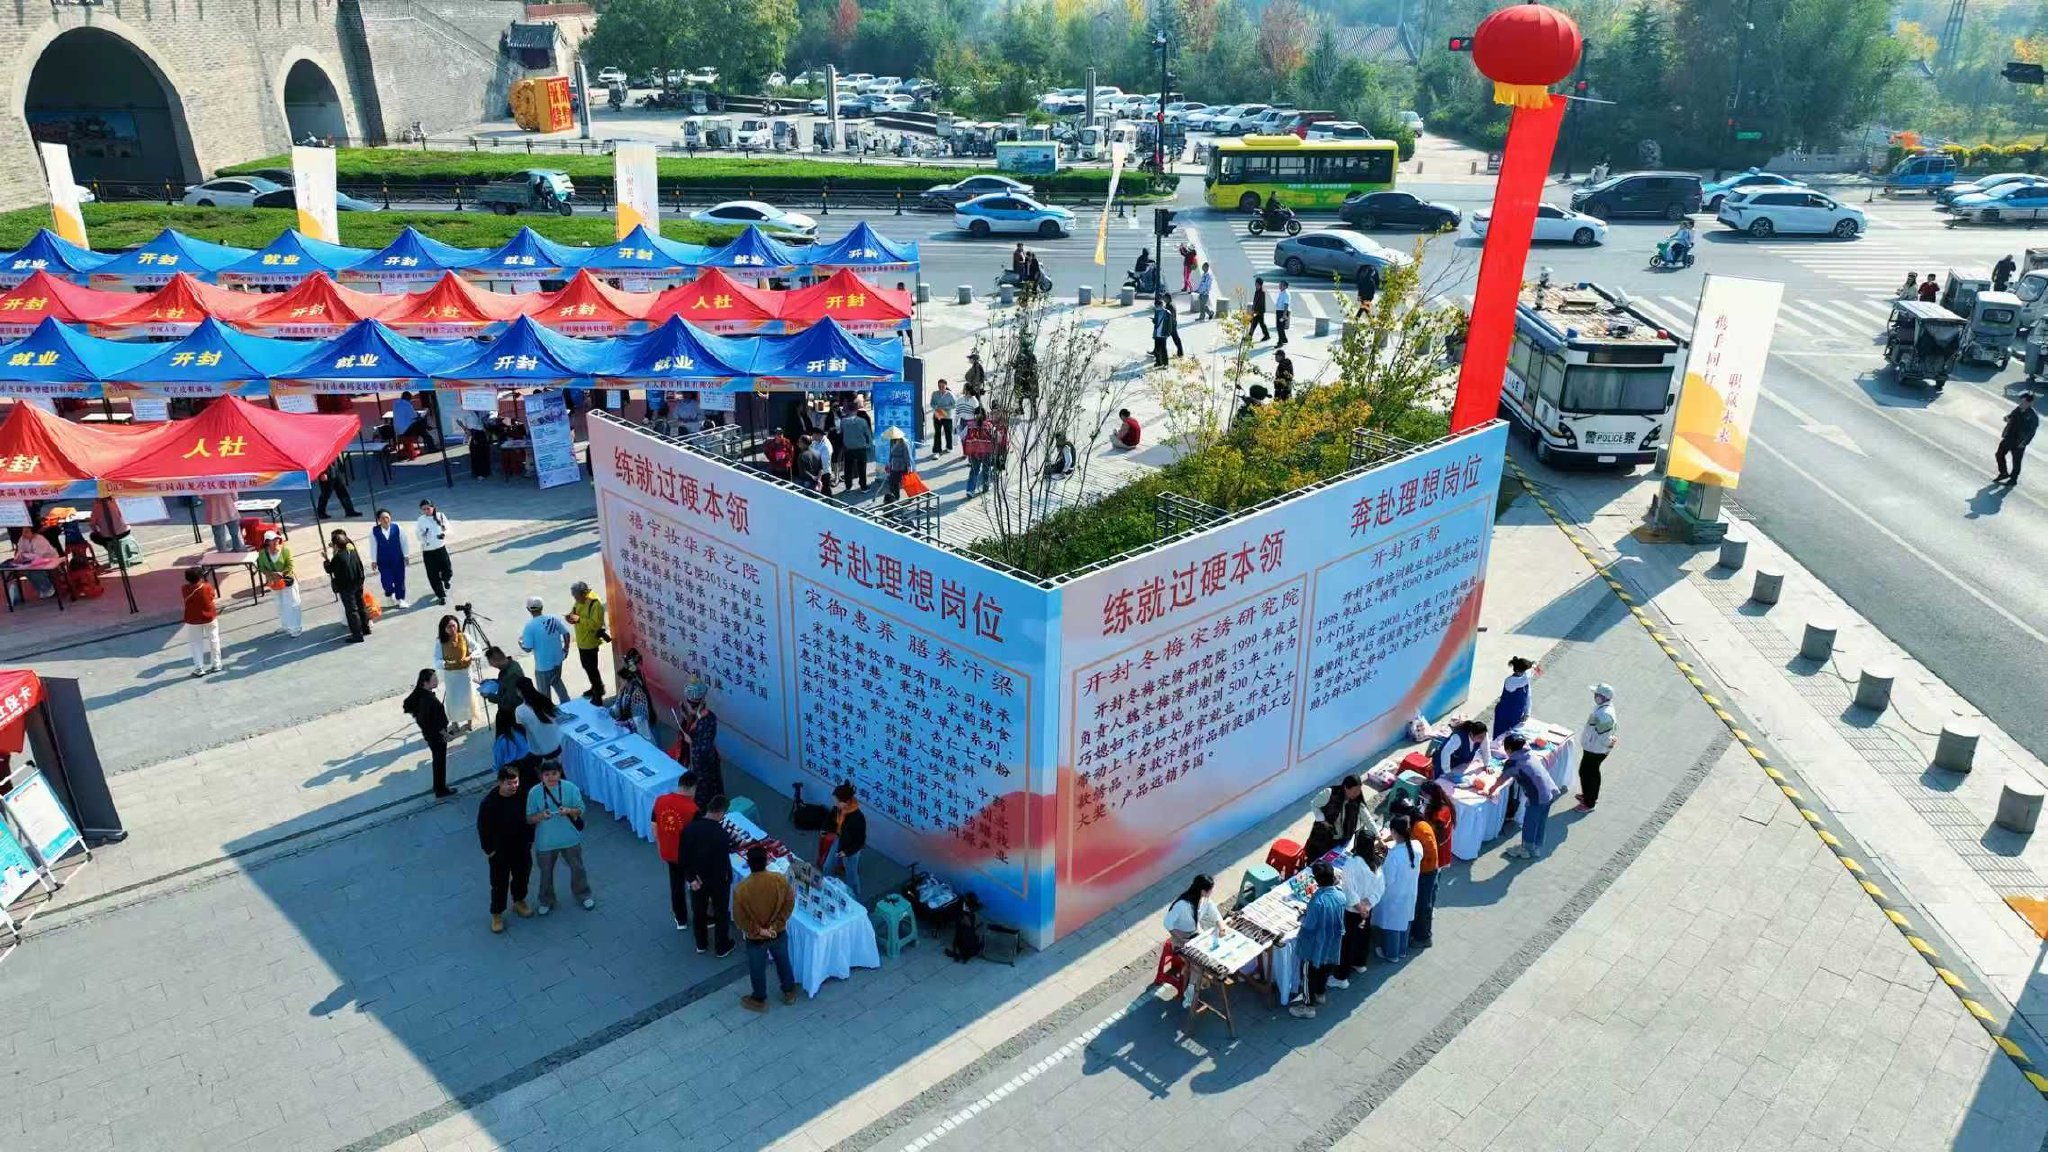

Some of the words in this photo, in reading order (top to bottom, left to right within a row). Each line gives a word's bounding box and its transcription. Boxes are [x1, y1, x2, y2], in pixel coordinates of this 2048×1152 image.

[138, 252, 180, 266] 开封
[263, 254, 300, 265] 就业
[383, 256, 419, 267] 开封
[503, 255, 537, 266] 就业
[618, 247, 654, 261] 开封
[733, 254, 766, 266] 就业
[848, 249, 879, 259] 开封
[11, 259, 49, 269] 就业
[4, 297, 48, 311] 开封
[691, 294, 733, 309] 人社
[825, 294, 867, 309] 开封
[151, 308, 186, 319] 人社
[291, 303, 327, 317] 开封
[424, 306, 461, 318] 人社
[559, 303, 598, 316] 开封
[8, 351, 61, 367] 就业
[169, 350, 223, 367] 开封
[335, 353, 380, 369] 就业
[494, 355, 539, 371] 开封
[652, 354, 695, 371] 就业
[806, 358, 849, 373] 开封
[182, 436, 248, 459] 人社
[614, 448, 748, 533] 练就过硬本领
[1351, 454, 1481, 536] 奔赴理想岗位
[819, 530, 1003, 643] 奔赴理想岗位
[1103, 529, 1284, 637] 练就过硬本领
[1084, 586, 1299, 697] 开封冬梅宋绣研究院
[908, 633, 1014, 699] 膳养汴梁
[1094, 647, 1227, 719] 开封冬梅宋绣研究院
[1231, 632, 1258, 655] 1999
[1260, 614, 1299, 644] 年成立
[1226, 674, 1248, 694] 500
